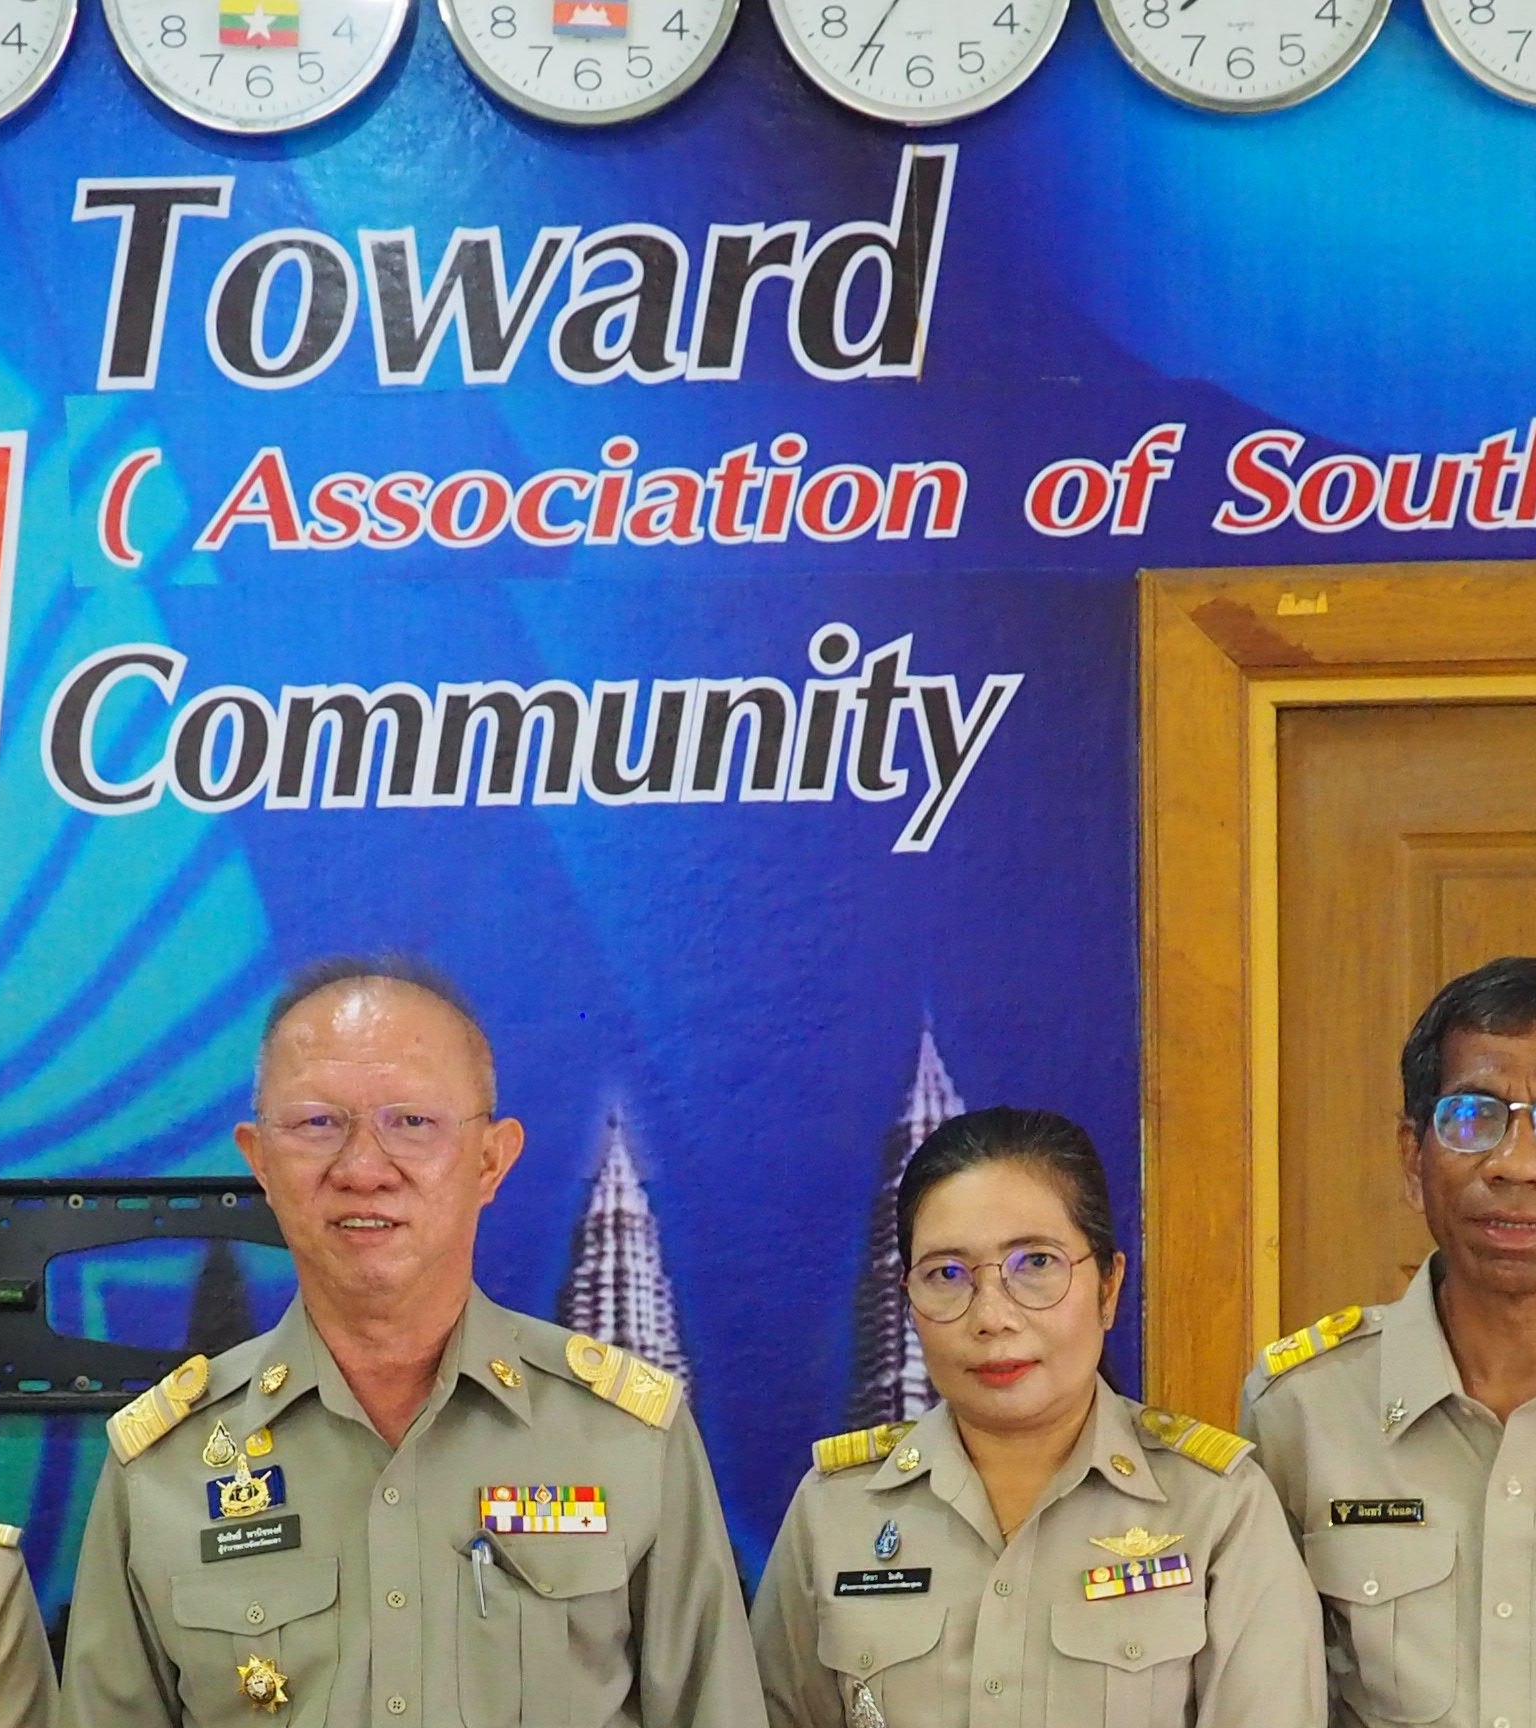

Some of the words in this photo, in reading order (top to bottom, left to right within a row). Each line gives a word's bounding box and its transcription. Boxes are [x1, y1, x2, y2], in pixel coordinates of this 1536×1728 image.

[160, 14, 187, 49] 8
[331, 15, 357, 46] 4
[490, 5, 517, 39] 8
[661, 8, 690, 41] 4
[820, 5, 849, 39] 8
[992, 2, 1021, 35] 4
[0, 22, 29, 55] 4
[1180, 34, 1207, 68] 7
[1279, 33, 1306, 67] 5
[1506, 29, 1533, 63] 7
[199, 53, 225, 87] 7
[297, 51, 324, 84] 5
[528, 45, 554, 78] 7
[573, 58, 603, 92] 6
[626, 45, 653, 79] 5
[859, 43, 886, 77] 7
[905, 54, 935, 89] 6
[958, 41, 985, 75] 5
[1226, 46, 1255, 80] 6
[245, 65, 274, 98] 6
[78, 148, 954, 386] Toward
[205, 436, 964, 546] Association
[1028, 427, 1180, 533] of
[46, 626, 1018, 850] Community
